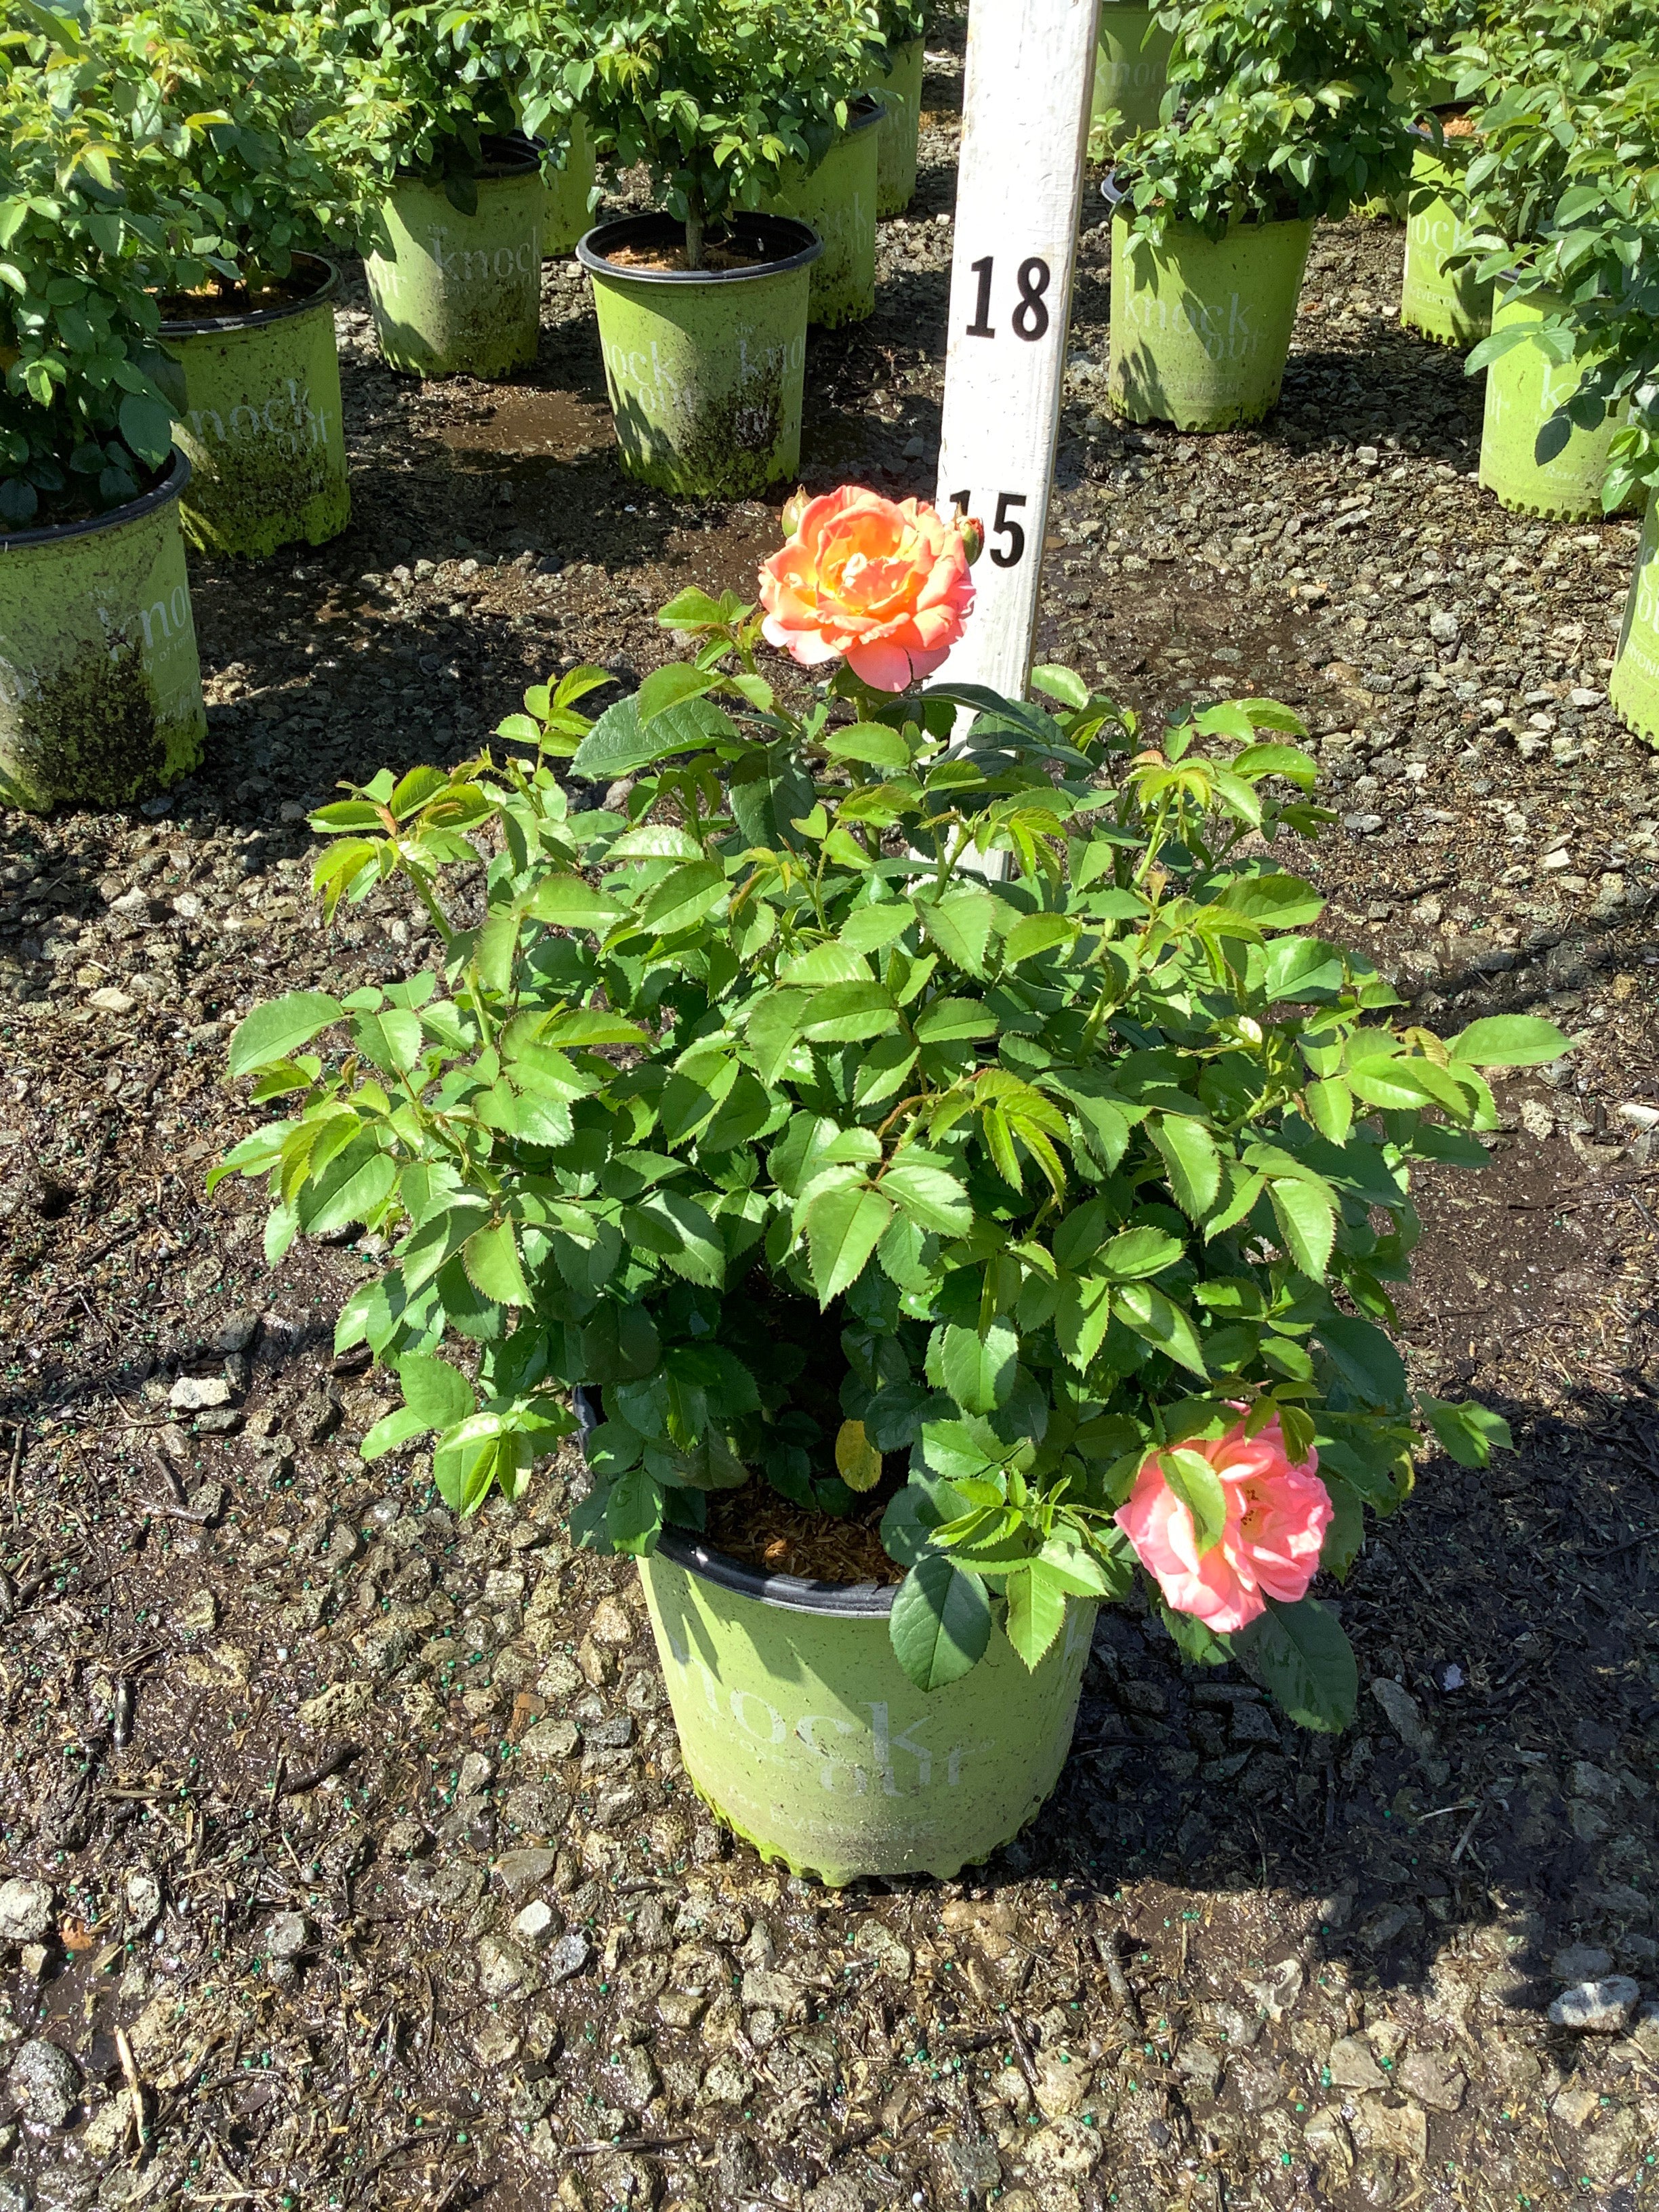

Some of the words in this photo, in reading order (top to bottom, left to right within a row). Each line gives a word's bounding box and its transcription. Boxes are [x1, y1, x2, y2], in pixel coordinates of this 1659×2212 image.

[966, 255, 1050, 341] 18
[1124, 274, 1253, 335] knock
[602, 337, 678, 391] ock
[188, 378, 315, 442] nock
